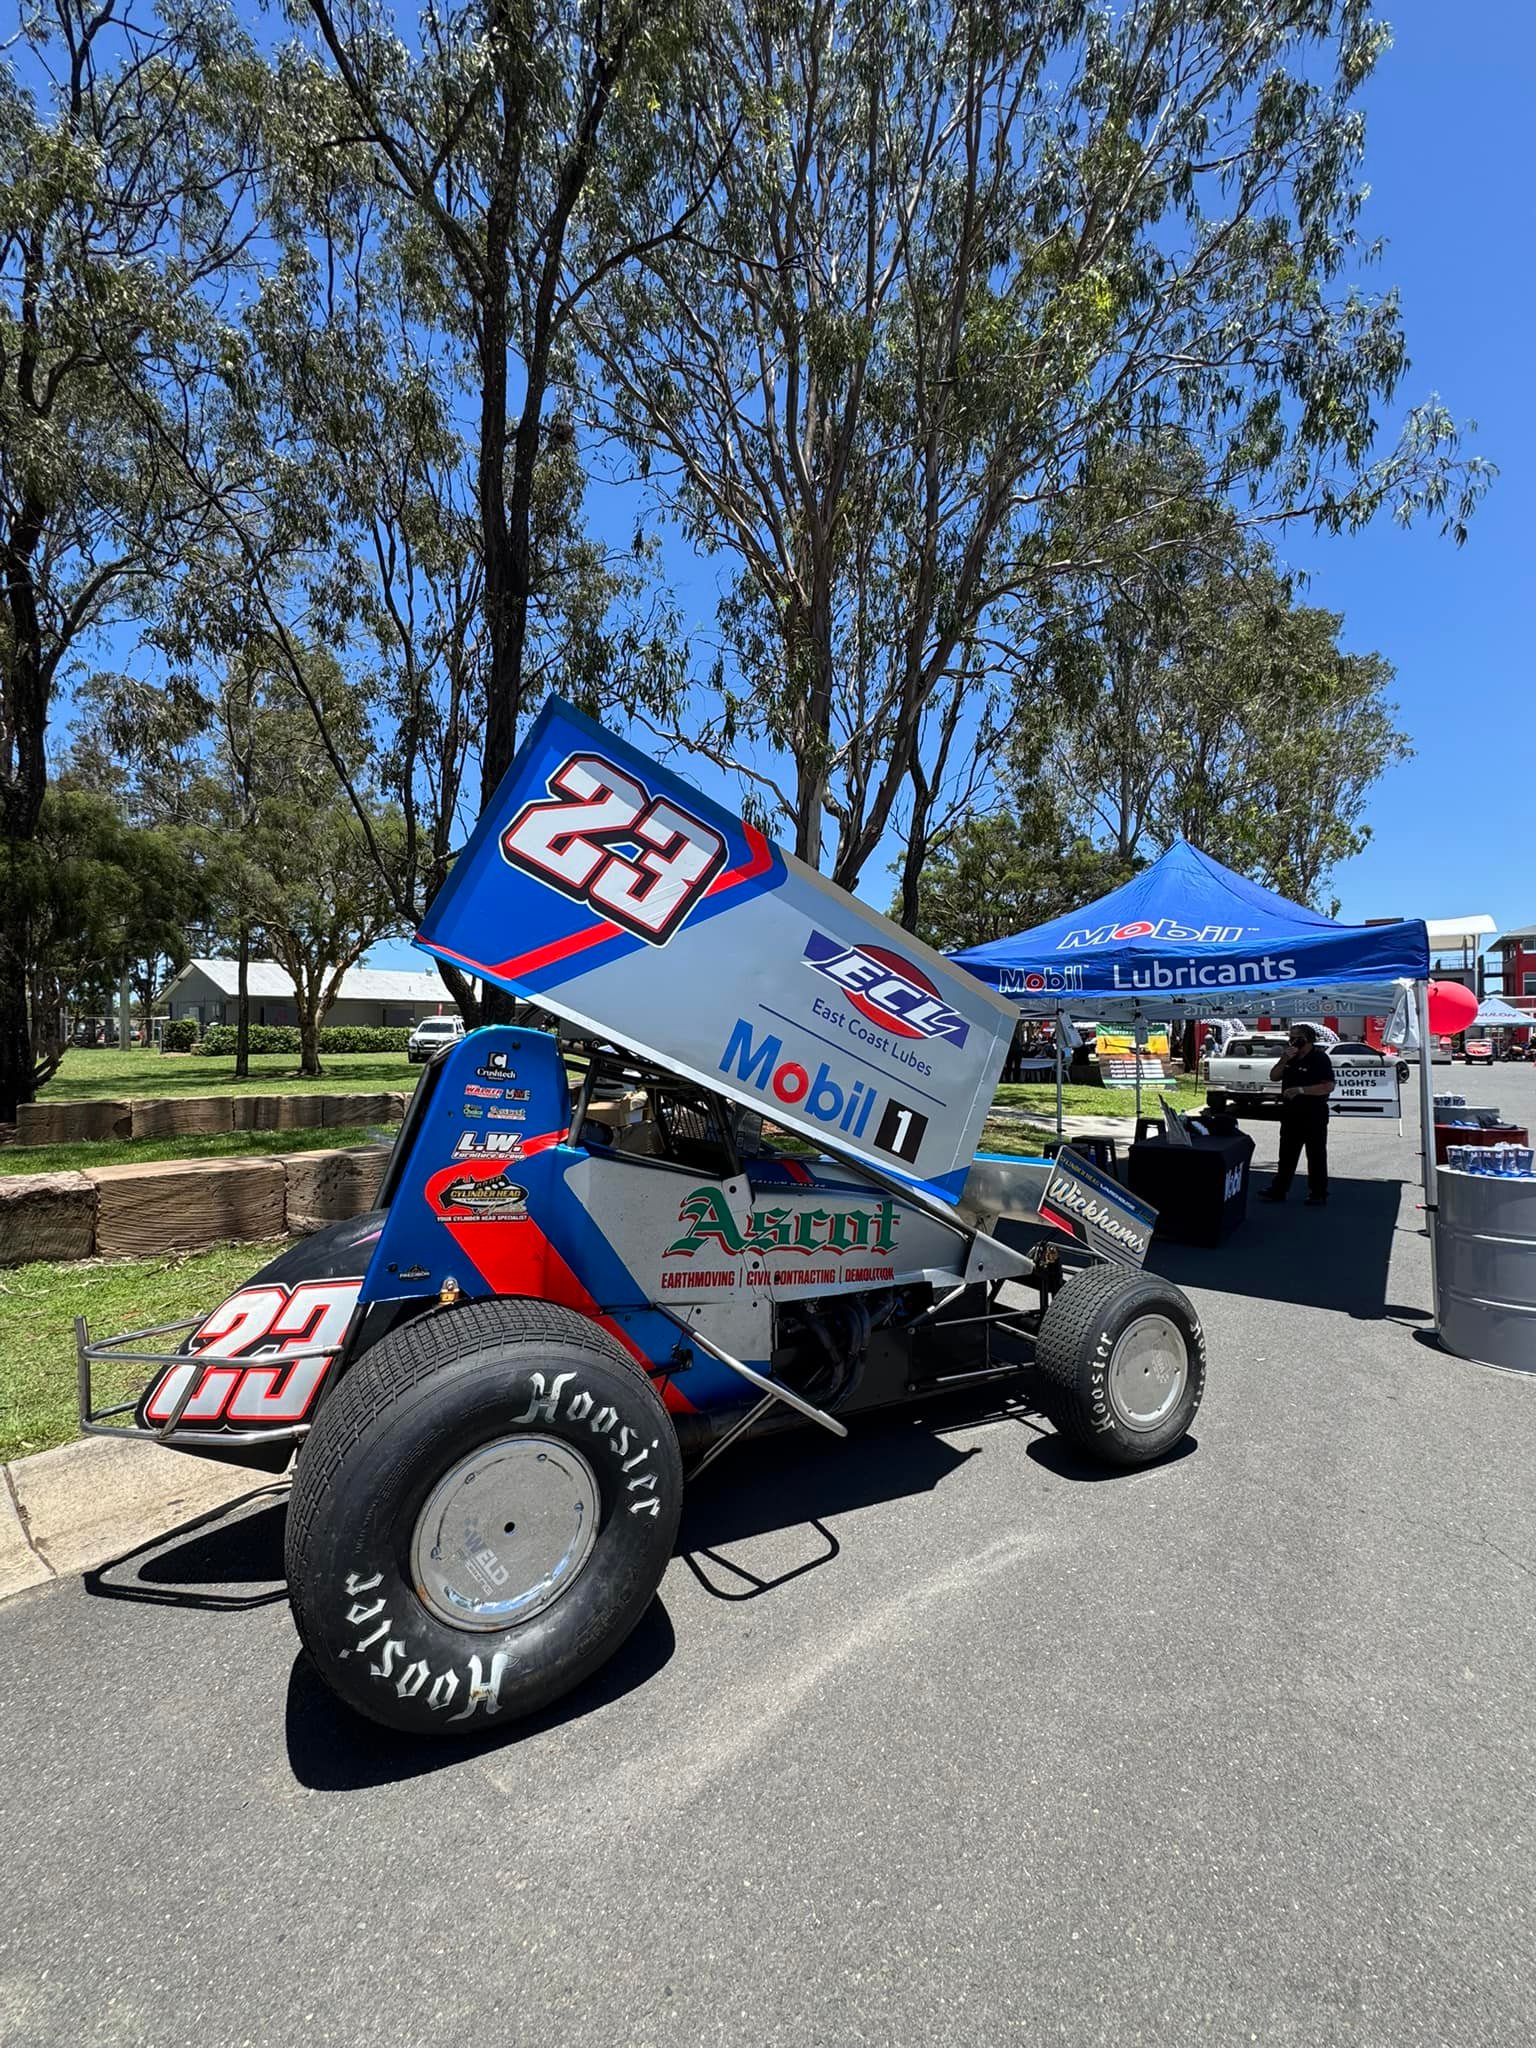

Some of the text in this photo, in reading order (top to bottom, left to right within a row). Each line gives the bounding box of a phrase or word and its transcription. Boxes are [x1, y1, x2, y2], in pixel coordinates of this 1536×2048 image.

[499, 750, 729, 948] 23
[1056, 919, 1242, 949] Mobil
[801, 946, 962, 1039] ECL
[999, 957, 1297, 993] Mobil Lubricants
[477, 1068, 516, 1079] Crushtech
[812, 998, 933, 1077] East Coast Lubes
[718, 1018, 913, 1153] Mobil 1
[450, 1190, 521, 1198] CYLINDER HEAD
[453, 1151, 525, 1160] Furniture Group
[662, 1186, 900, 1259] Ascot
[1048, 1177, 1145, 1254] Wickhams
[661, 1267, 895, 1289] EARTHMOVING CIVIL CONTRACTING DEMOLITION
[145, 1279, 366, 1428] 23
[1088, 1331, 1116, 1433] Hoosier
[511, 1371, 661, 1518] Hoosier
[338, 1569, 519, 1723] Hoosier
